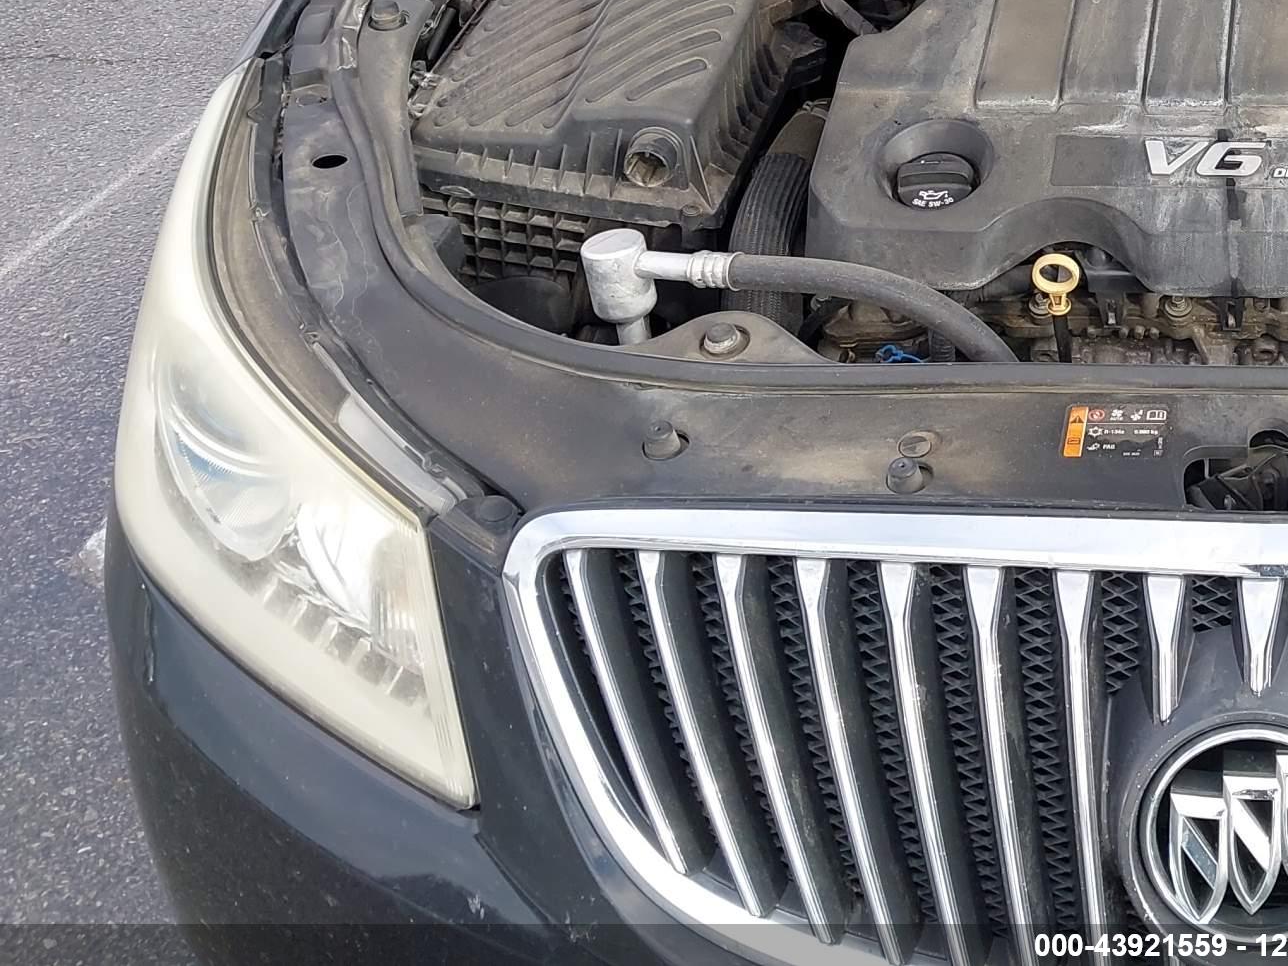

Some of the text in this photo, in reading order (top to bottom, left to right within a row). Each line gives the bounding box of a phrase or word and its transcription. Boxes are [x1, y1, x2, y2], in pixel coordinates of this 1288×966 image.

[1145, 140, 1267, 176] V6
[912, 197, 954, 207] SAE 5W-30
